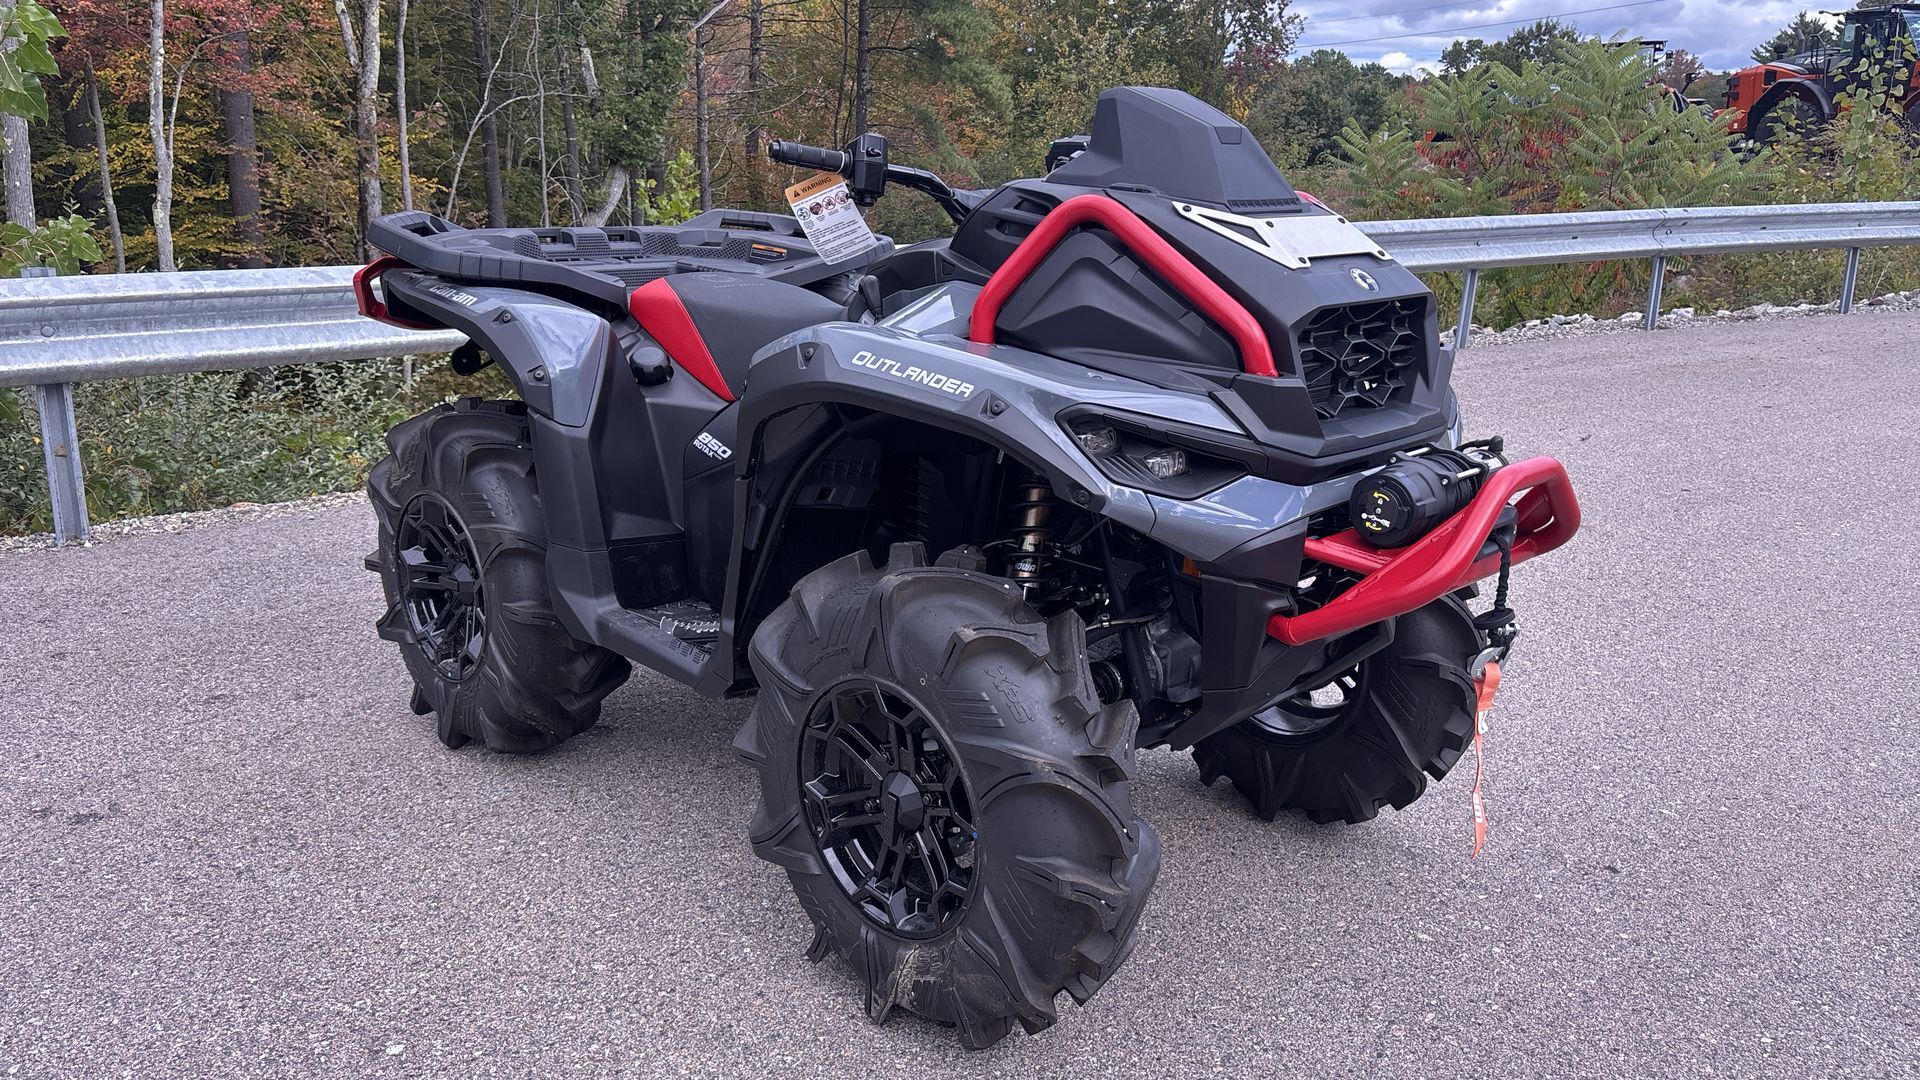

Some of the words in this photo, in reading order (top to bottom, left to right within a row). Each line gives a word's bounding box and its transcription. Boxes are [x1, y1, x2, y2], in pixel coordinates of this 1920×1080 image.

[801, 176, 832, 193] WARNING
[851, 350, 975, 398] OUTLANDER
[692, 438, 715, 458] ROTAX
[697, 431, 733, 459] 850
